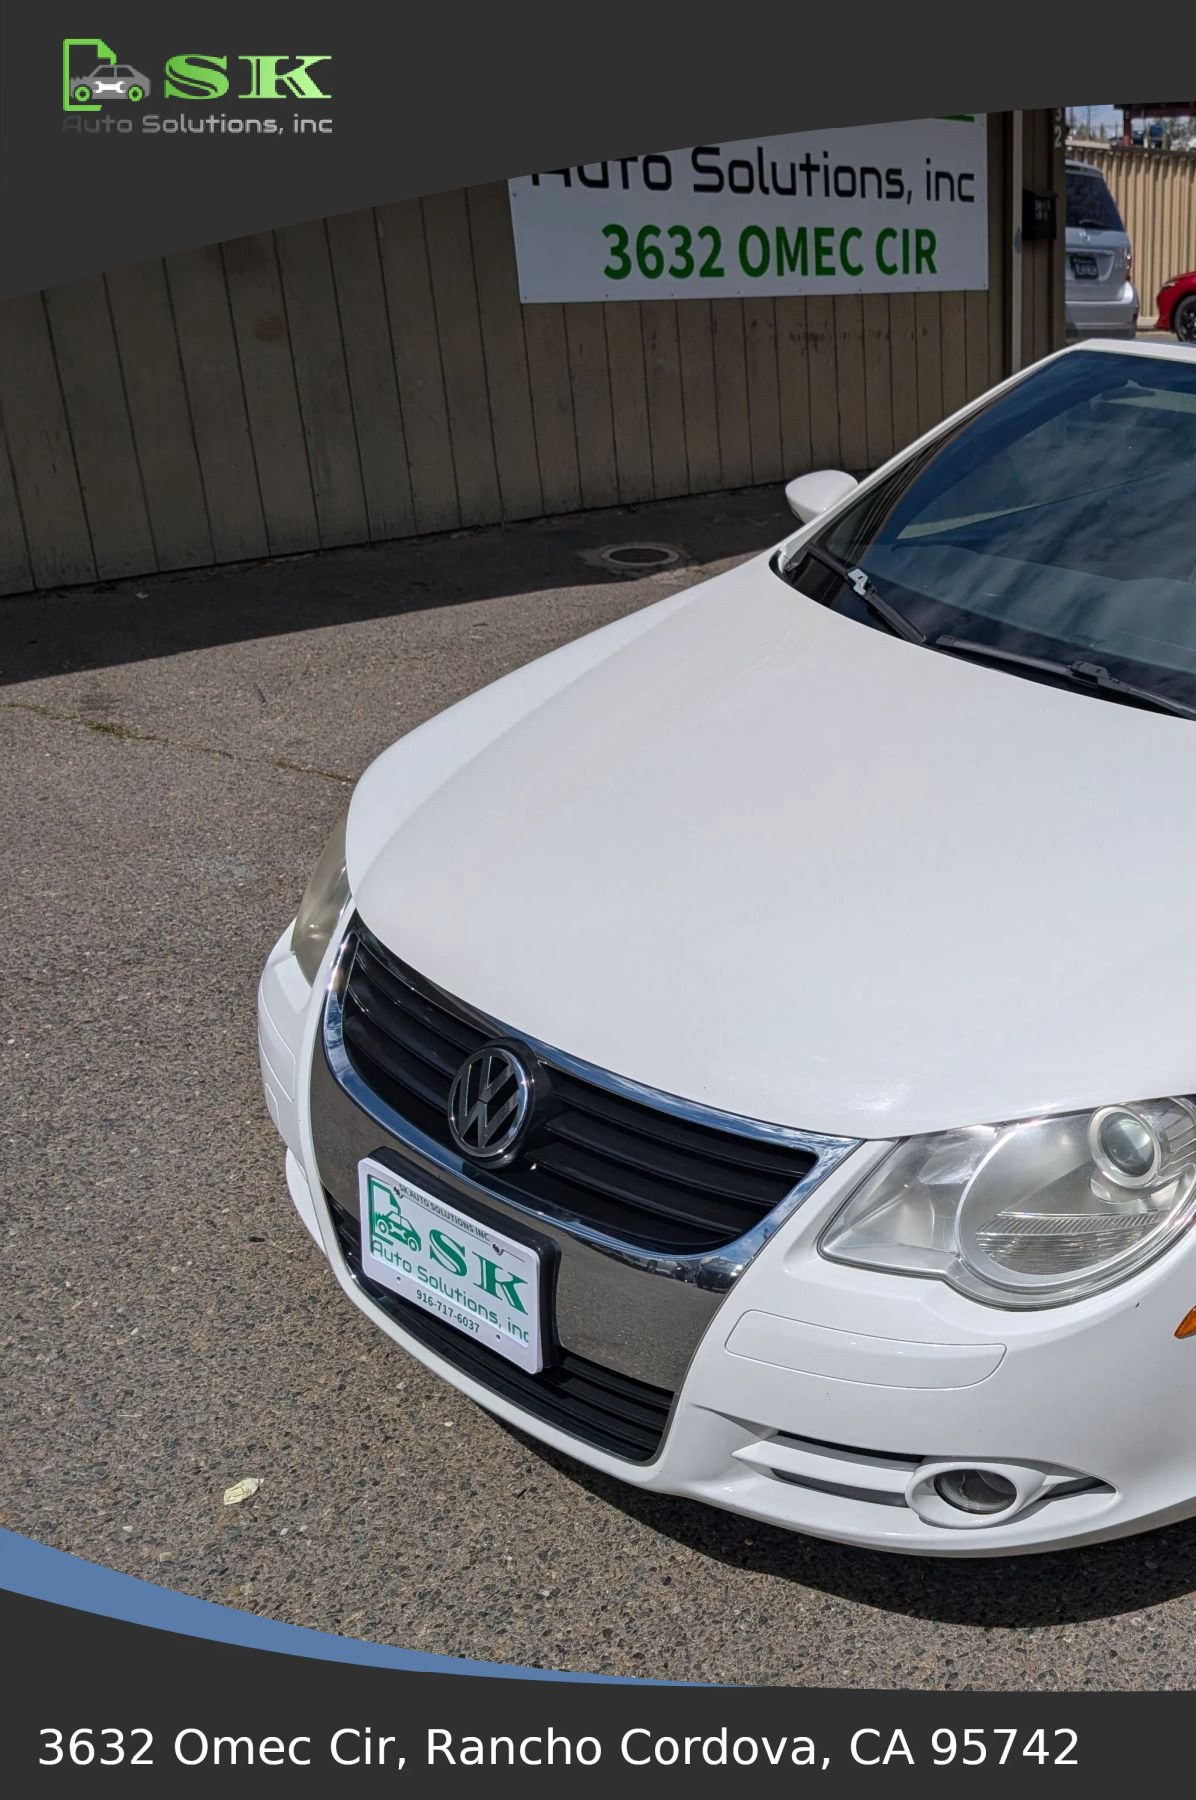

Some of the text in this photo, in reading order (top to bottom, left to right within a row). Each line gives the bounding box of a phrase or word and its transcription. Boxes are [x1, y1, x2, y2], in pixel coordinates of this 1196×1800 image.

[691, 146, 912, 205] Solutions,
[926, 158, 975, 203] inc
[601, 224, 937, 280] 3632 OMEC CIR
[409, 1191, 430, 1208] AUTO
[431, 1202, 474, 1233] SOLUTIONS
[475, 1227, 490, 1242] INC
[371, 1239, 412, 1274] Auto
[417, 1261, 502, 1329] Solutions,
[429, 1228, 528, 1316] SK
[416, 1289, 480, 1334] 916-717-6037
